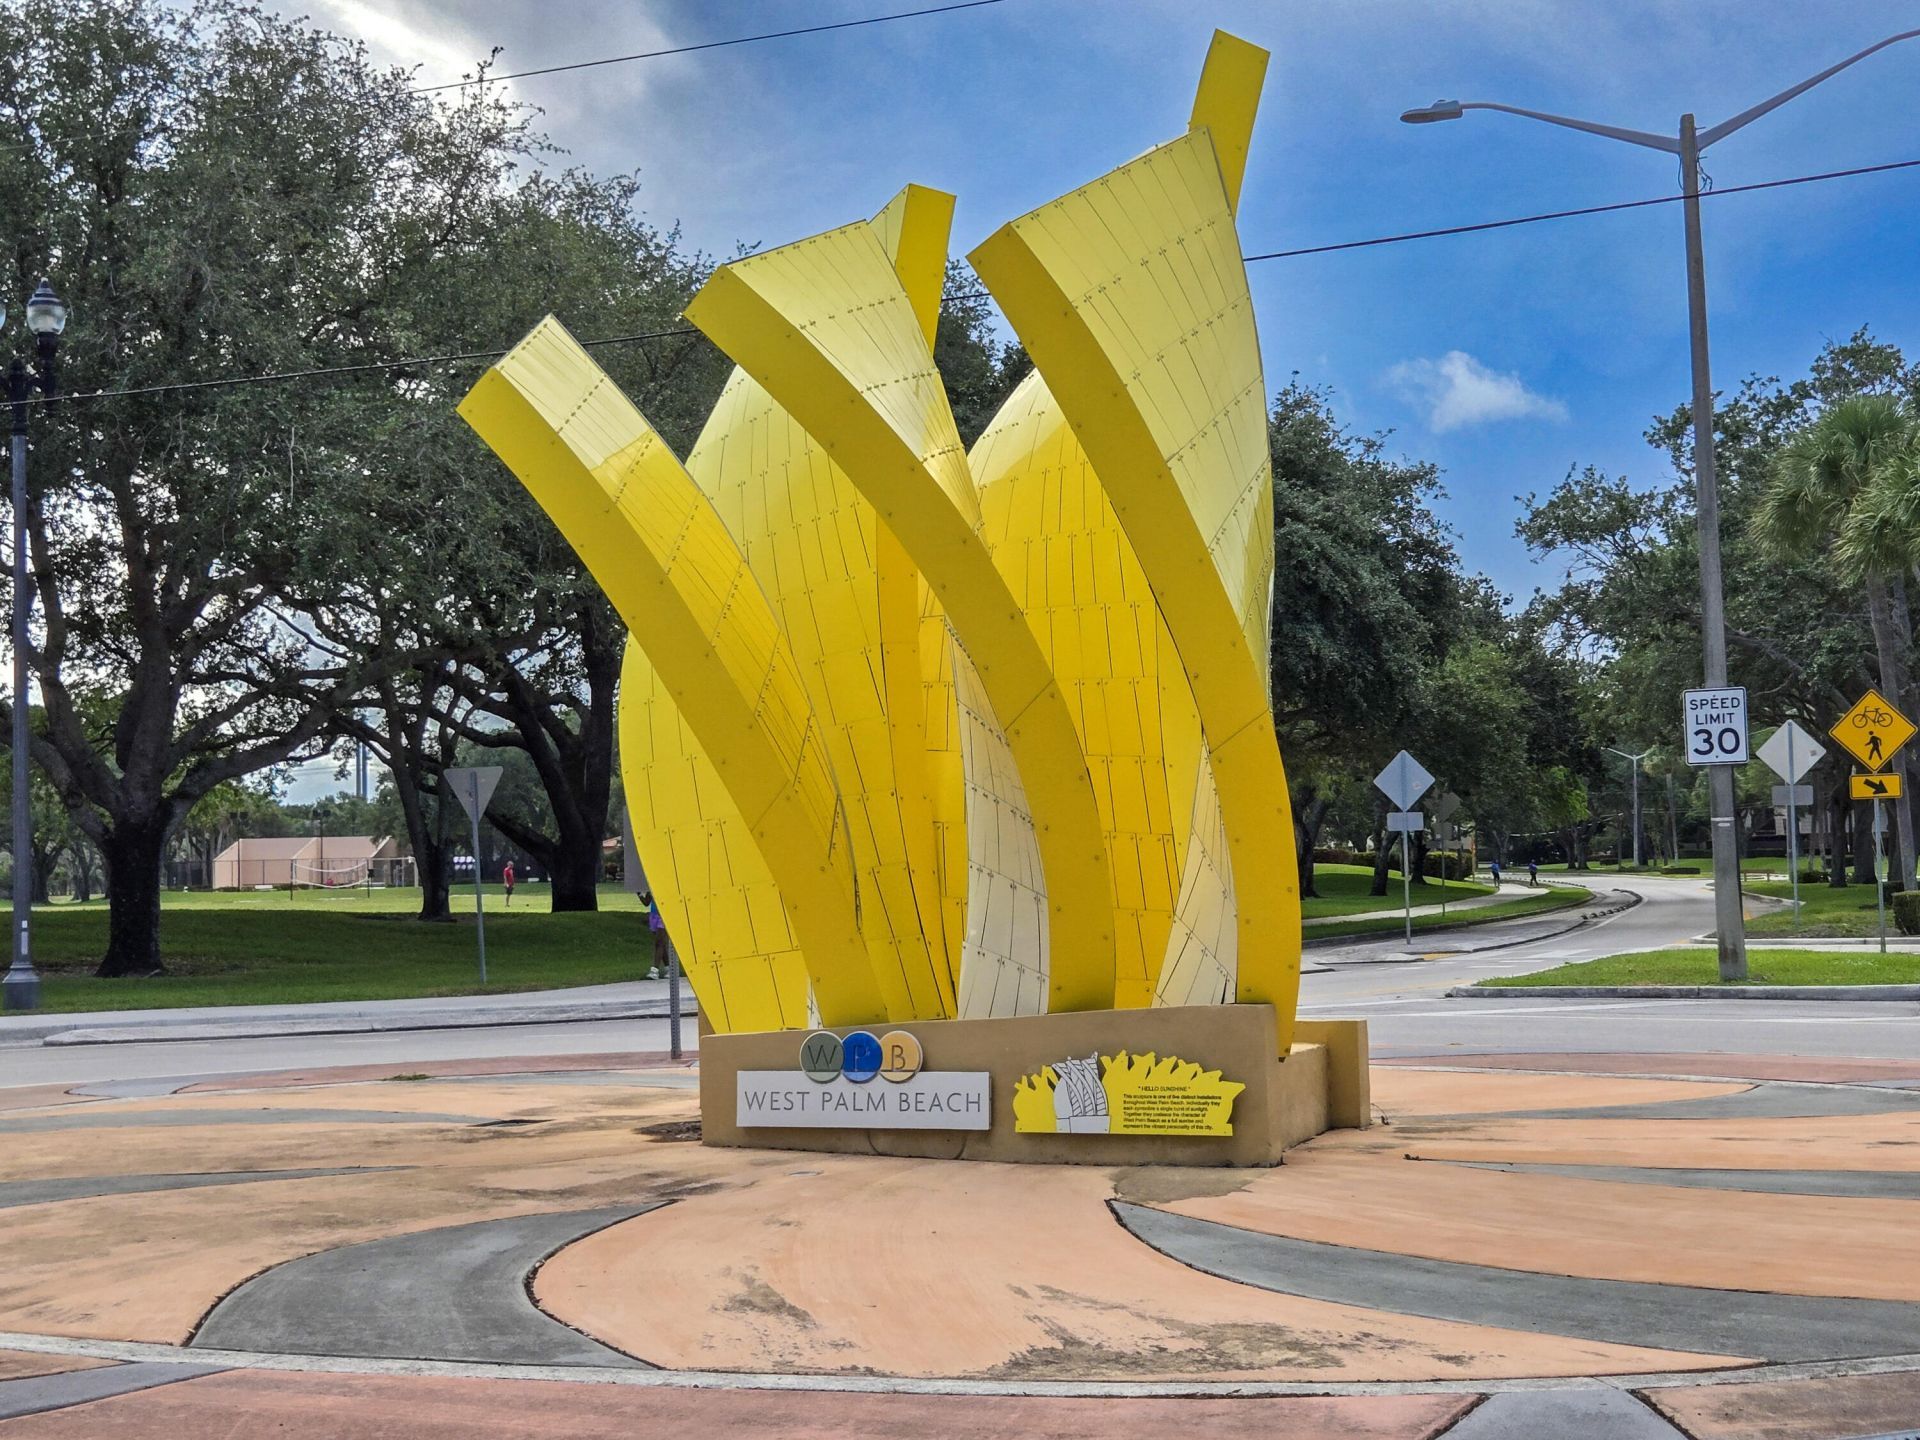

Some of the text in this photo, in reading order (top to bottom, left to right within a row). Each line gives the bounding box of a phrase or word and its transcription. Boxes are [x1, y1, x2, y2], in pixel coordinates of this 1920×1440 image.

[1689, 697, 1740, 710] SPEED
[1695, 712, 1735, 725] LIMIT
[1693, 727, 1740, 755] 30
[744, 1091, 981, 1113] WEST PALM BEACH
